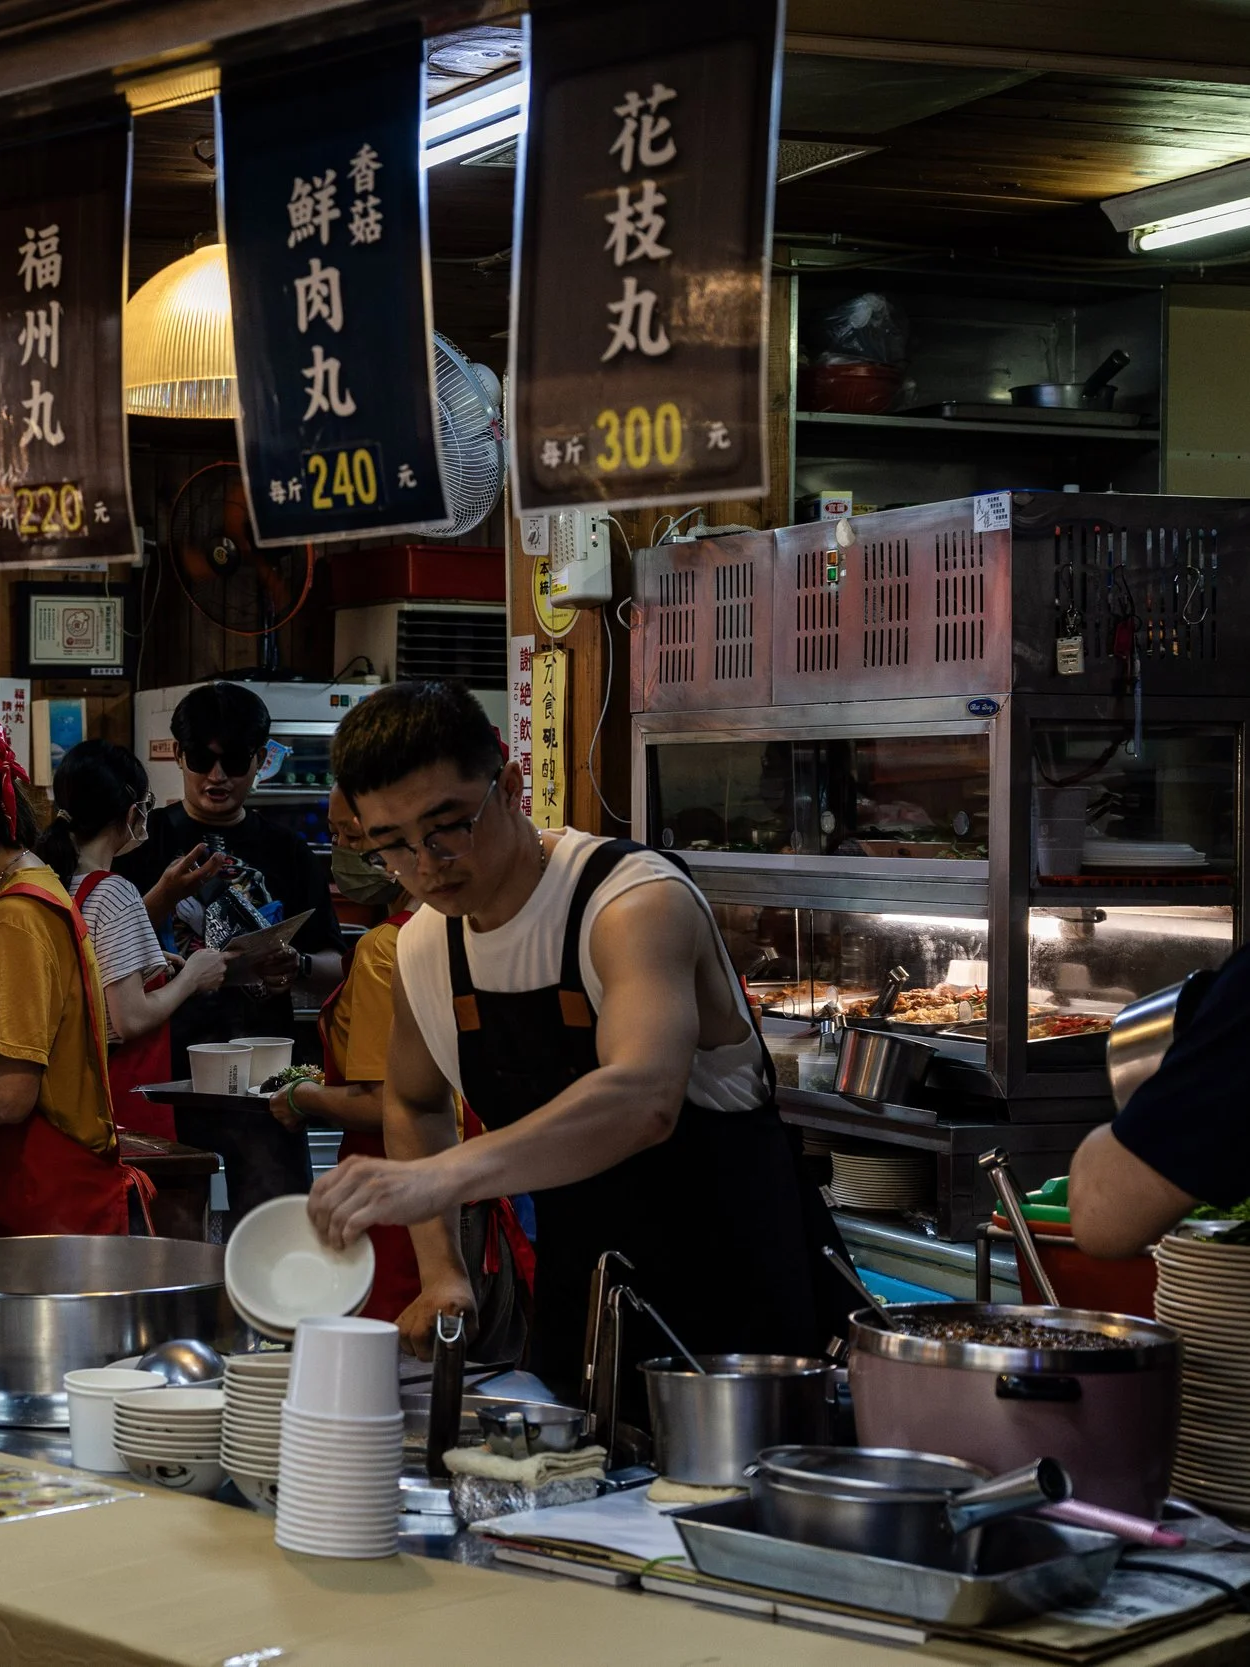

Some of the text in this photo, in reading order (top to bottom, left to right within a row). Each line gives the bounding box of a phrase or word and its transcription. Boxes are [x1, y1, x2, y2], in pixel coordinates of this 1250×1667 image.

[347, 144, 383, 246] 香菇
[600, 83, 677, 363] 花枝丸
[17, 223, 66, 449] 福州丸
[287, 169, 357, 422] 鮮肉丸
[307, 447, 377, 510] 240
[396, 463, 418, 489] 元
[595, 403, 682, 470] 300
[707, 421, 731, 450] 元
[15, 483, 83, 534] 220
[519, 647, 533, 777] 謝絕飲酒
